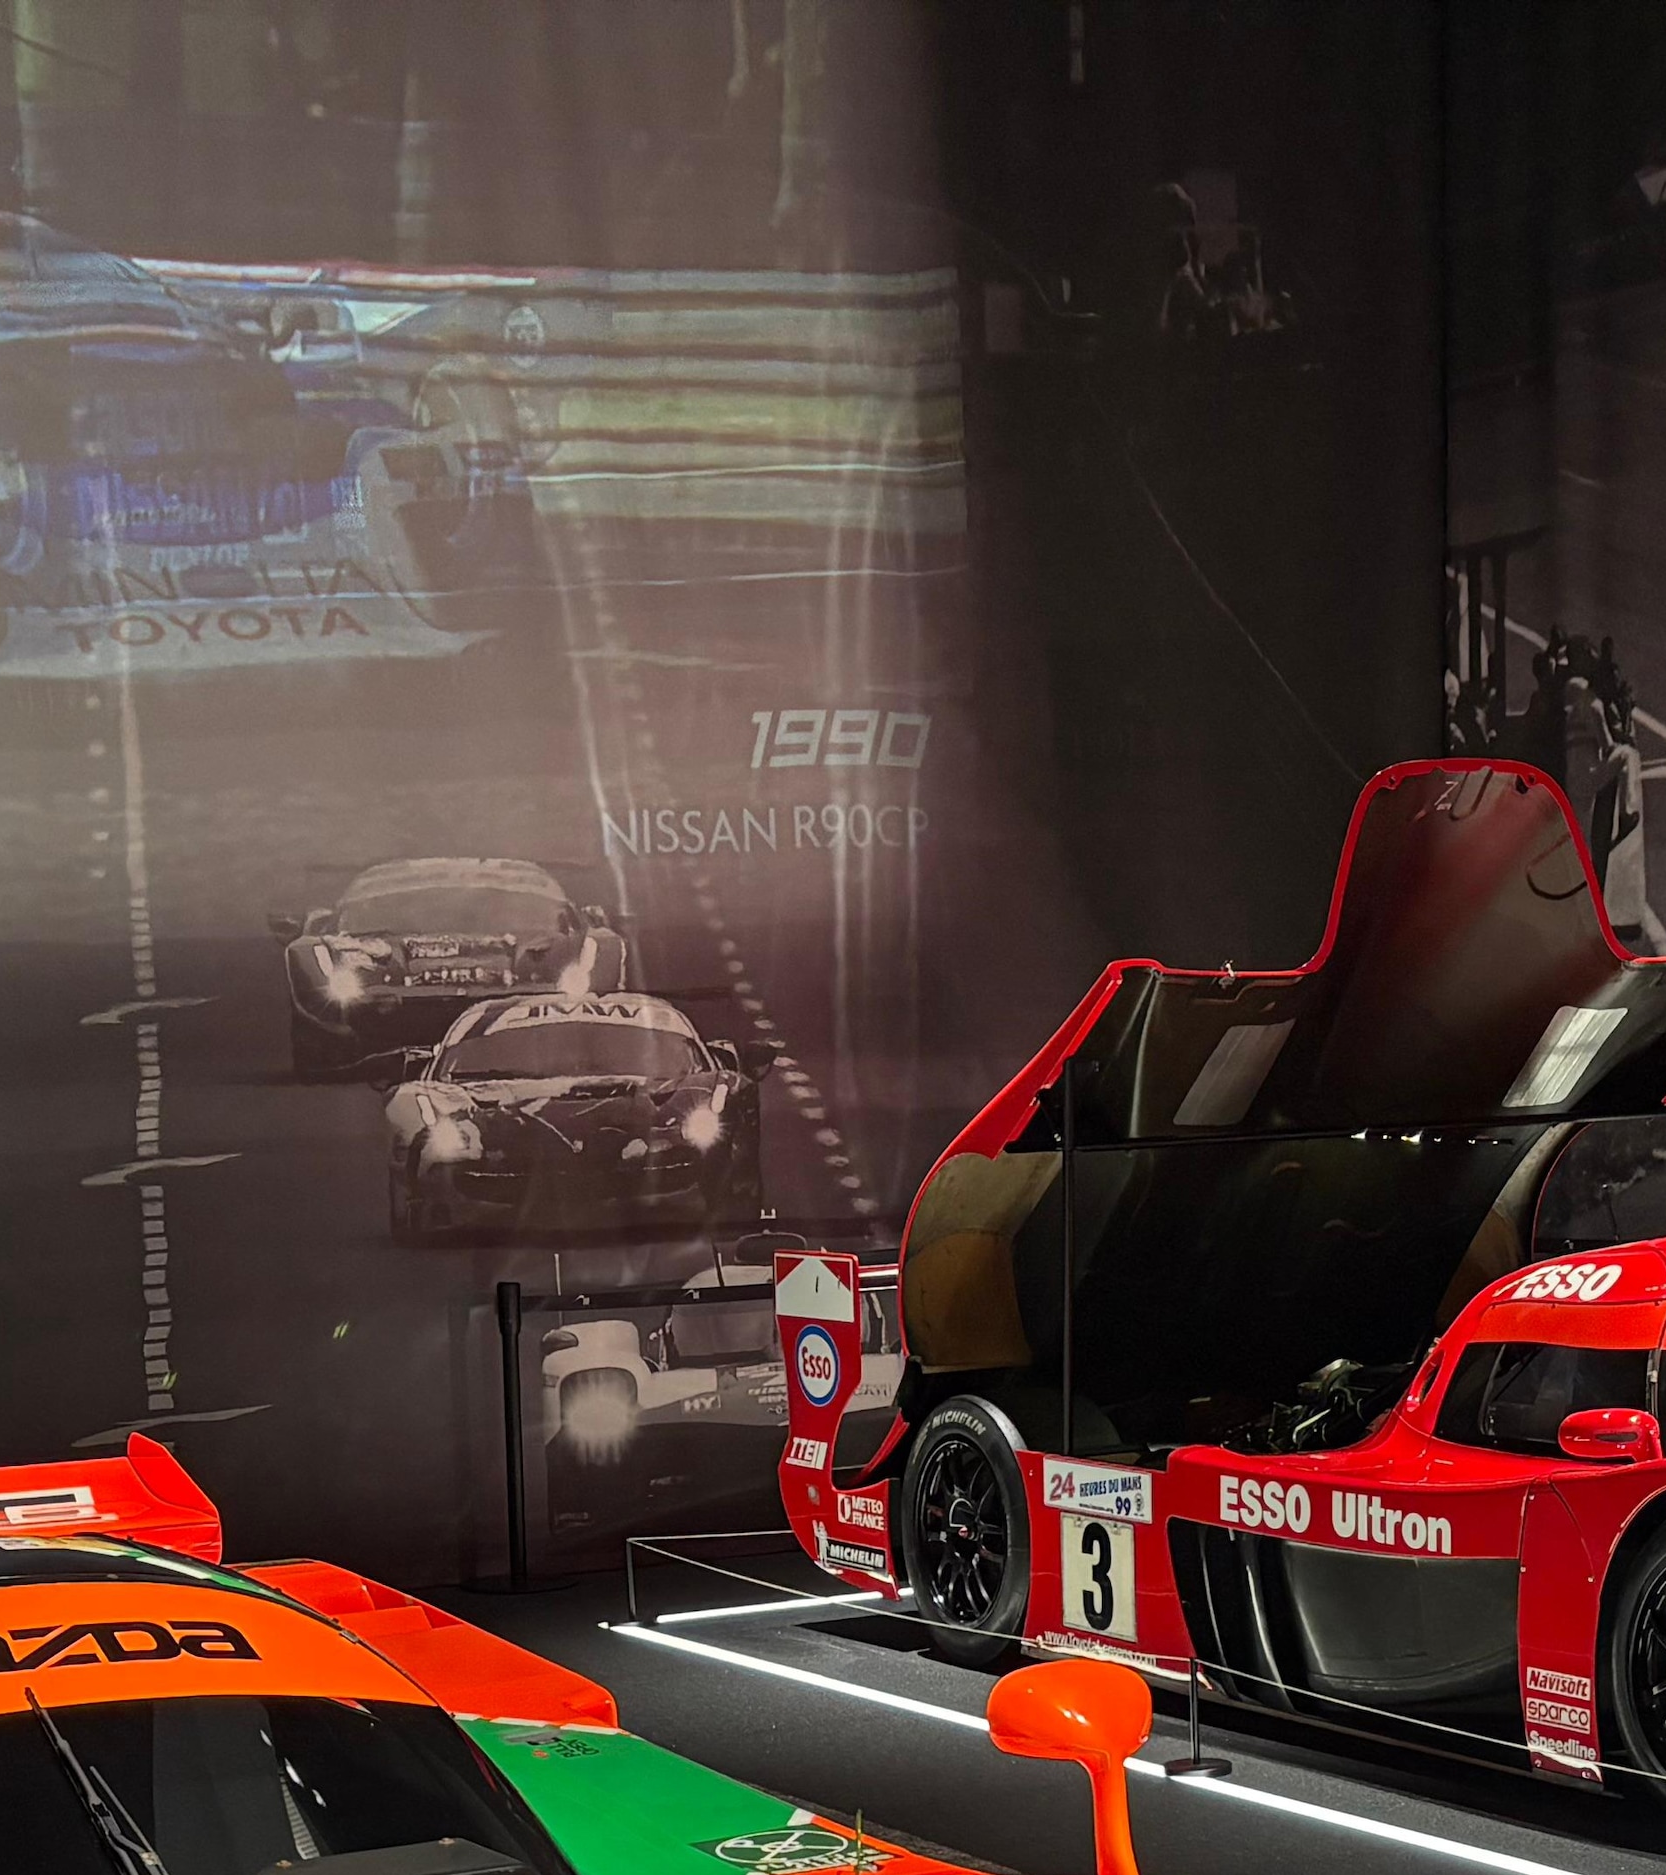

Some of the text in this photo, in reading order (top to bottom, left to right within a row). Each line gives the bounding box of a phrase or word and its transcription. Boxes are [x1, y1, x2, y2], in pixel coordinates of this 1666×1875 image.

[57, 606, 369, 655] TOYOTA
[751, 709, 932, 768] 1990
[602, 803, 930, 856] NISSAN R90CP
[1493, 1263, 1623, 1302] ESSO
[932, 1411, 986, 1435] MICHELIN
[1049, 1471, 1142, 1501] 24 HEURES DU MANS
[852, 1512, 885, 1530] FRANCE
[1115, 1496, 1131, 1516] 99
[1219, 1475, 1452, 1555] ESSO Ultron
[830, 1544, 884, 1567] MICHELIN
[1081, 1522, 1114, 1631] 3
[1529, 1670, 1588, 1697] Navisoft
[1528, 1701, 1589, 1726] sparco
[1530, 1730, 1596, 1760] Speedline
